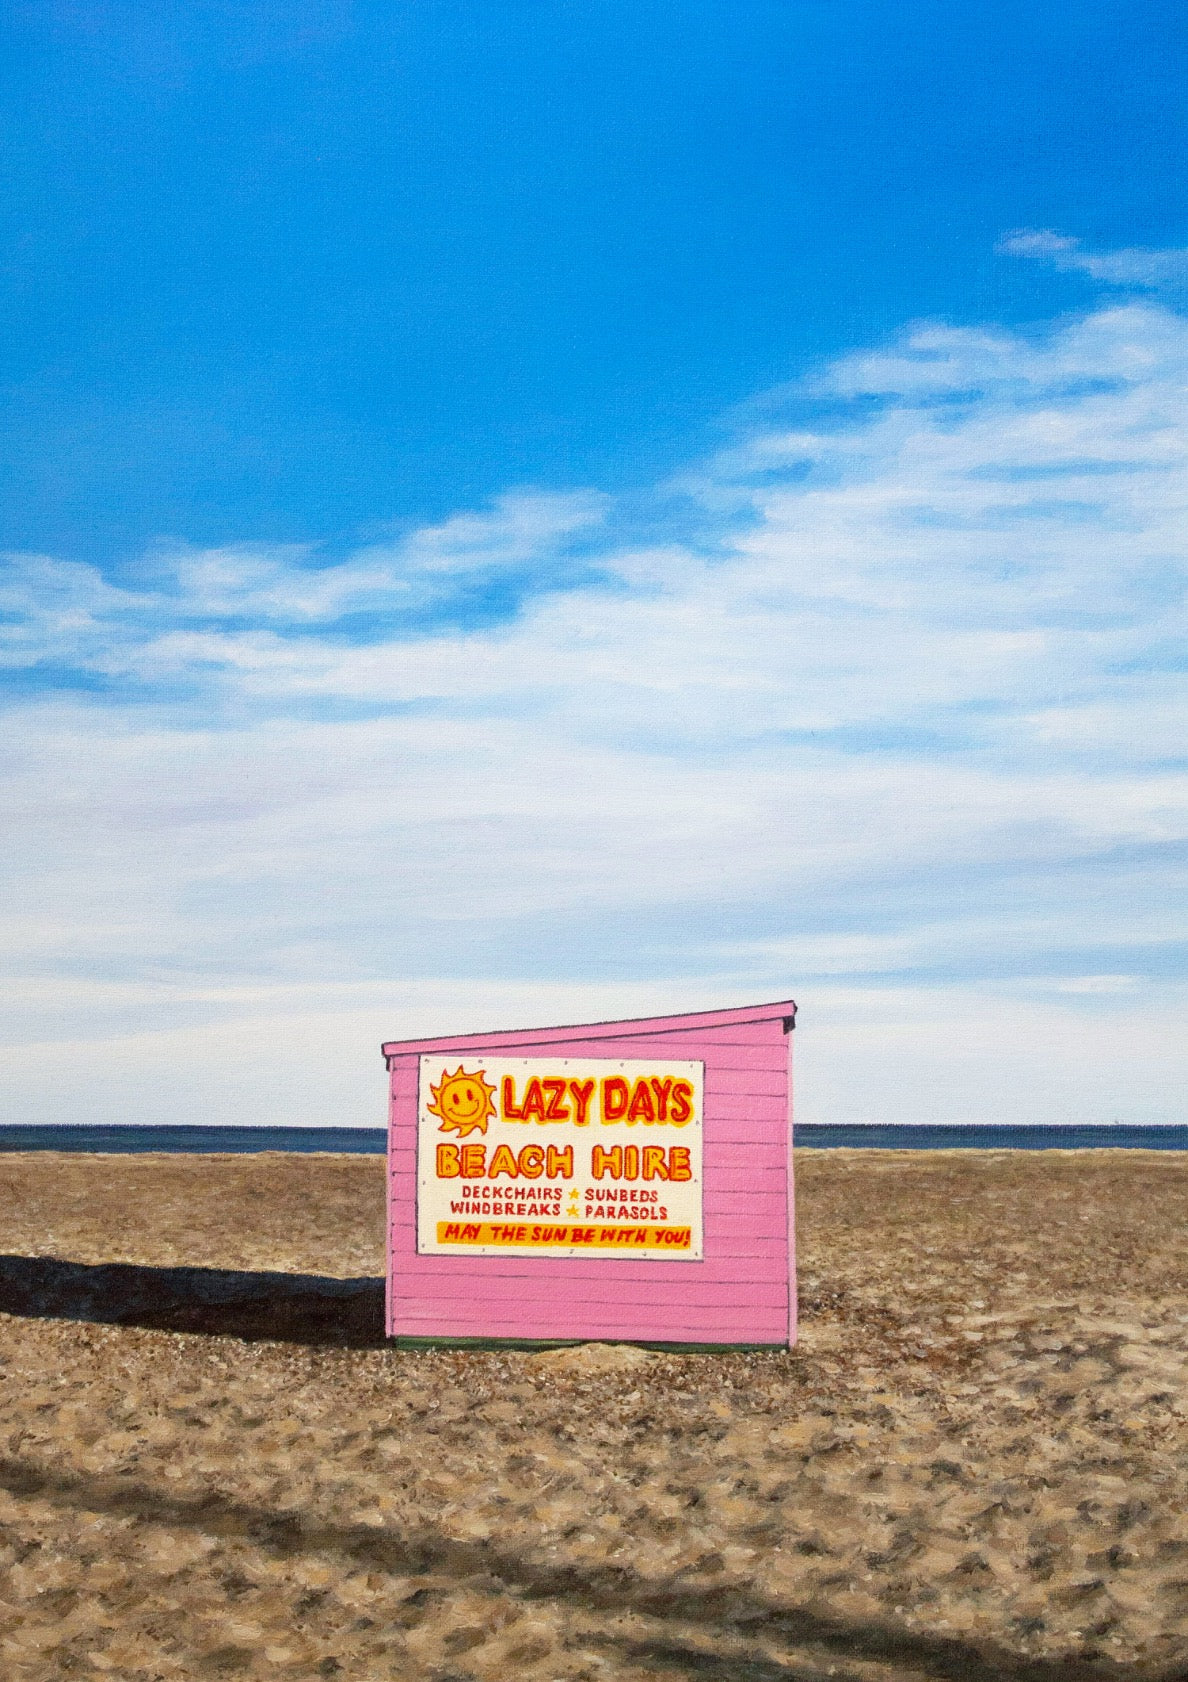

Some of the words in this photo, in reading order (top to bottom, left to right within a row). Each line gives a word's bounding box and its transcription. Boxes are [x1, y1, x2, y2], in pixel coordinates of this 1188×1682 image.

[502, 1076, 596, 1125] LAZY
[602, 1076, 693, 1125] DAYS
[436, 1143, 573, 1179] BEACH
[591, 1145, 692, 1181] HIRE
[462, 1185, 563, 1201] DECKCHAIRS
[584, 1188, 659, 1203] SUNBEDS
[450, 1200, 561, 1216] WINDBREAKS
[585, 1204, 668, 1220] PARASOLS
[444, 1223, 482, 1240] MAY
[490, 1224, 527, 1241] THE
[531, 1226, 568, 1242] SUN
[570, 1228, 596, 1243] BE
[600, 1228, 647, 1243] WITH
[655, 1229, 691, 1247] YOU!
